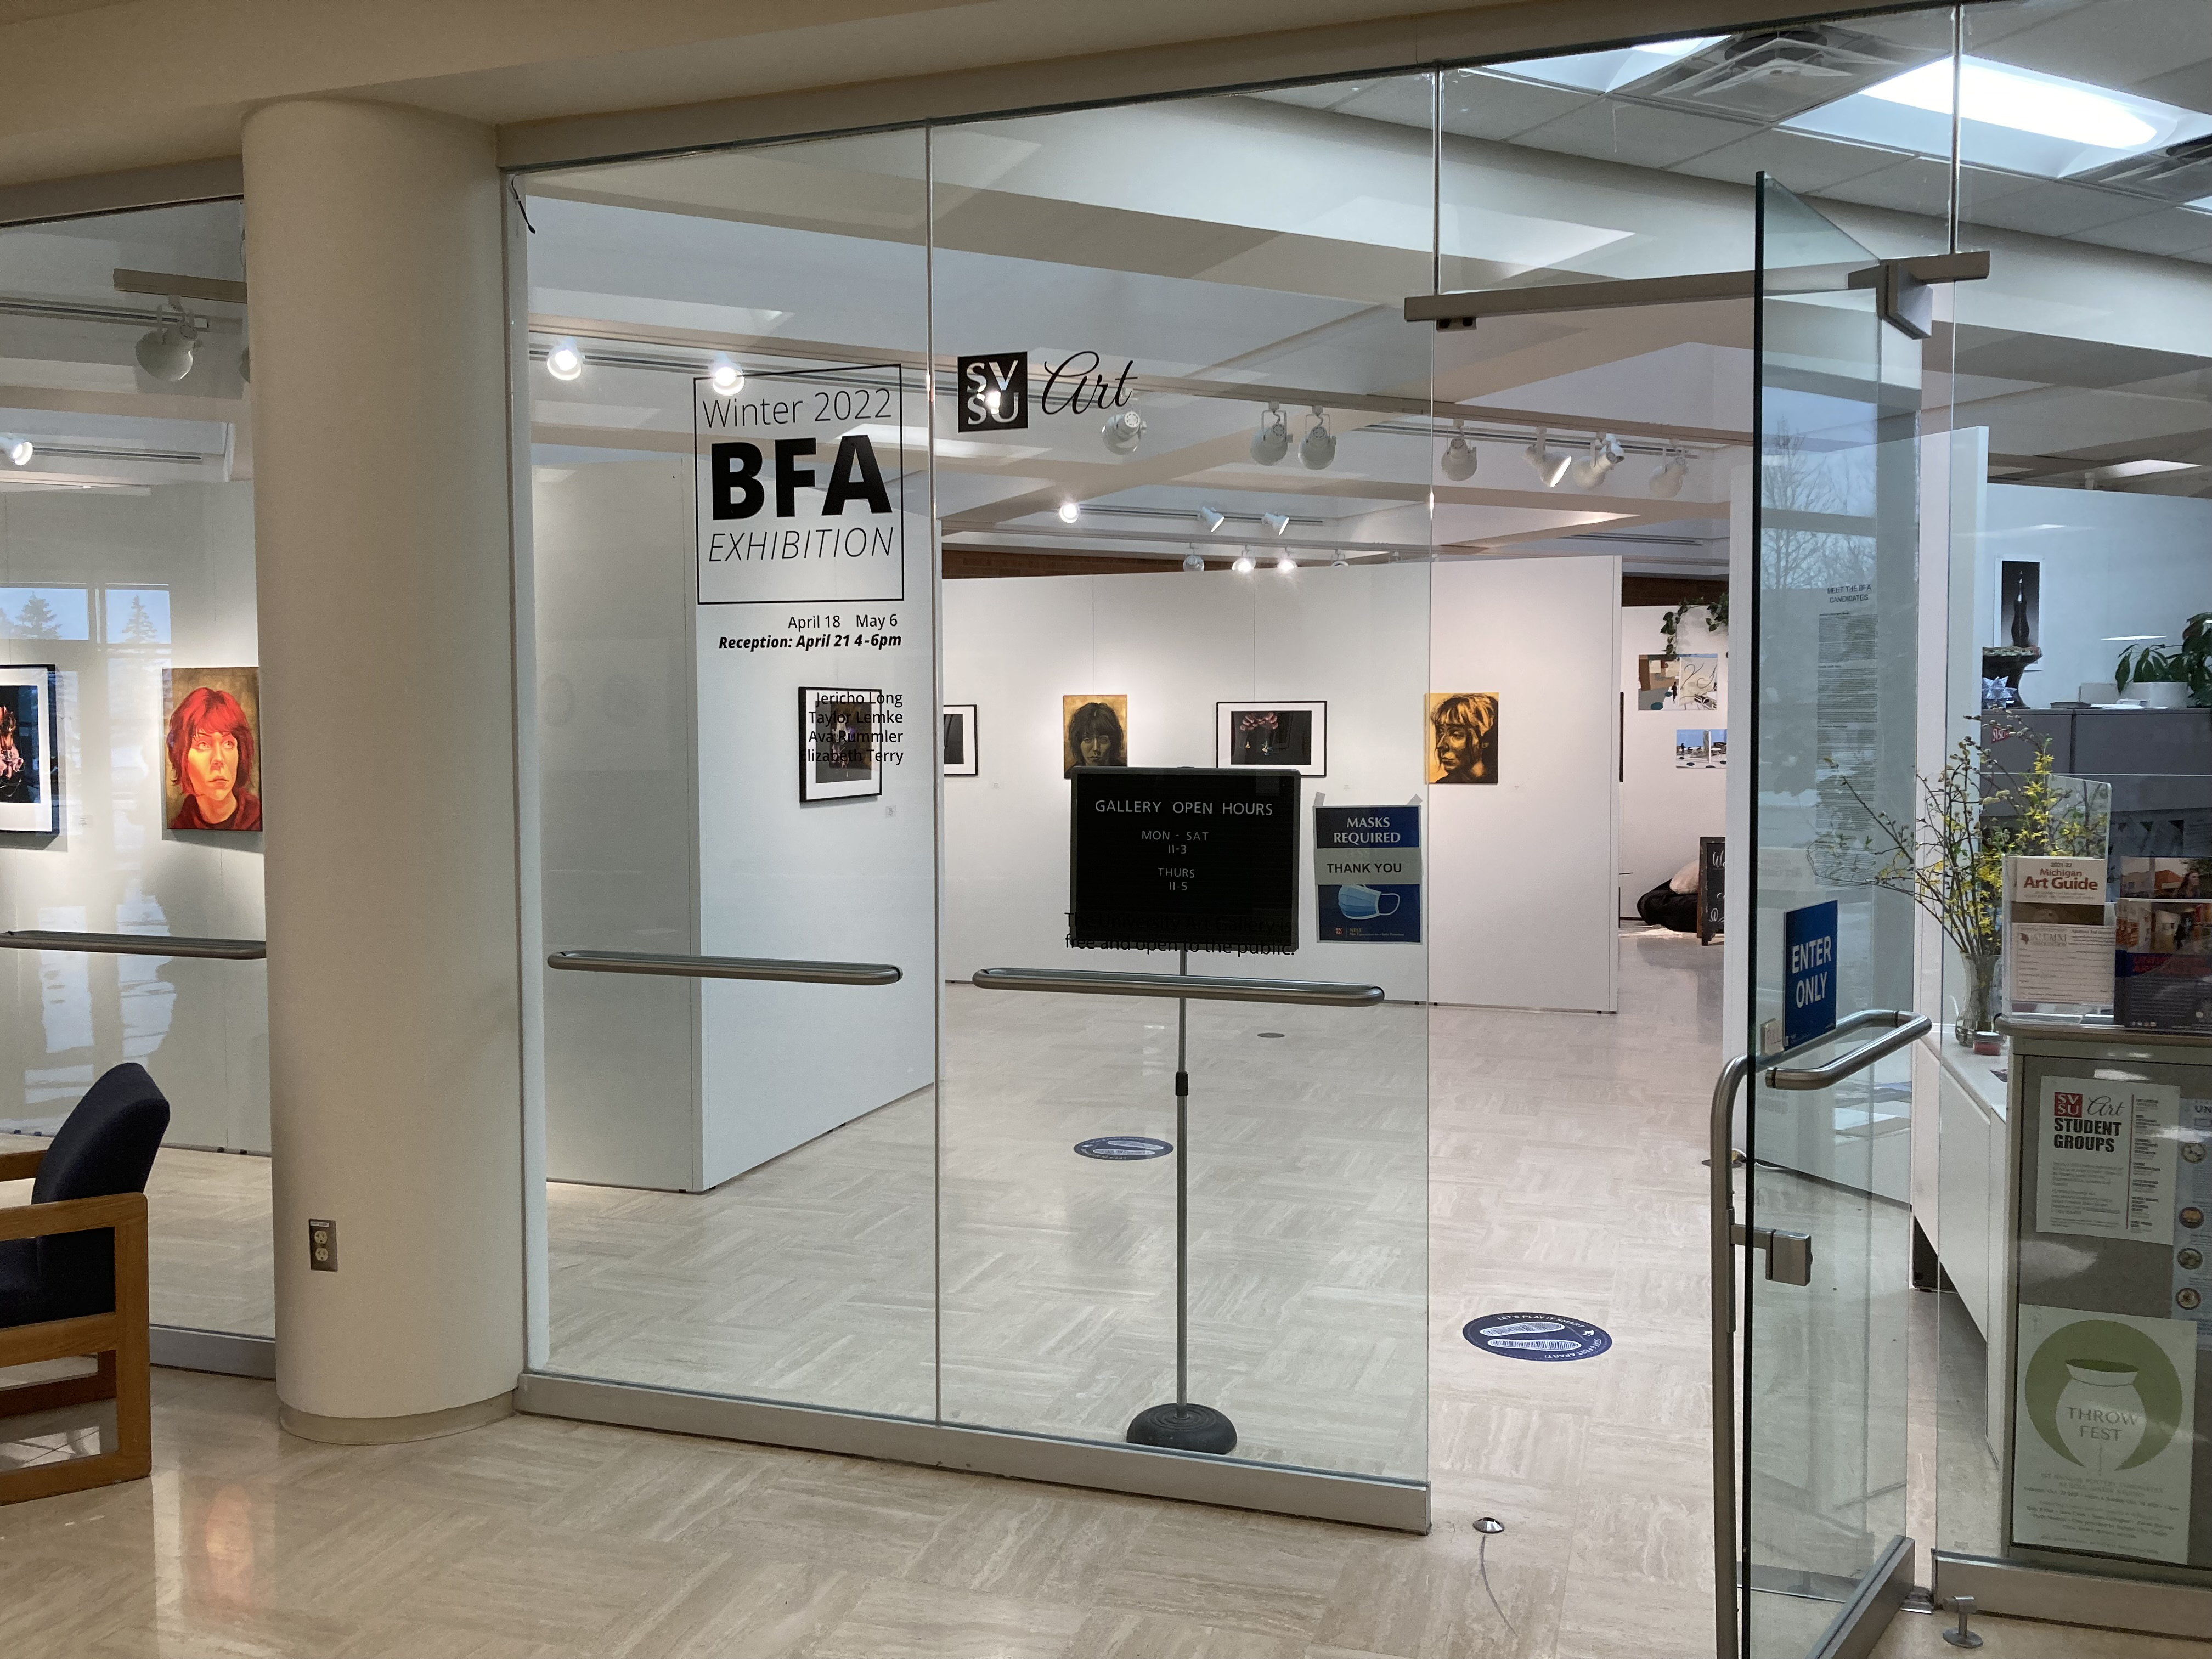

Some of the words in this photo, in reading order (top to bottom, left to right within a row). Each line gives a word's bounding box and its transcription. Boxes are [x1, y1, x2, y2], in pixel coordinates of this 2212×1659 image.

[1041, 351, 1138, 415] Art
[703, 397, 803, 429] Winter
[814, 387, 892, 422] 2022
[712, 435, 893, 521] BFA
[709, 527, 894, 562] EXHIBITION
[1830, 594, 1869, 603] CANDIDATES
[788, 615, 821, 631] April
[825, 615, 840, 628] 18
[856, 614, 885, 631] May
[889, 614, 898, 627] 6
[719, 635, 793, 652] Reception:
[796, 634, 831, 651] April
[833, 635, 850, 647] 21
[854, 634, 902, 649] 4-6pm
[816, 692, 864, 707] Jericho
[869, 692, 903, 708] Long
[809, 711, 852, 727] Taylor
[856, 710, 903, 724] Lemke
[809, 731, 834, 743] Ava
[839, 730, 904, 743] Rummler
[867, 748, 904, 766] Terry
[1096, 800, 1162, 814] GALLERY
[1172, 801, 1213, 815] OPEN
[1222, 802, 1273, 816] HOURS
[1347, 816, 1390, 828] MASKS
[1142, 830, 1170, 840] MON
[1187, 831, 1209, 842] SAT
[1333, 831, 1401, 844] REQUIRED
[1158, 867, 1195, 878] THURS
[1327, 863, 1370, 873] THANK
[1375, 862, 1402, 873] YOU
[2040, 868, 2083, 878] Michigan
[2024, 876, 2049, 888] Art
[2052, 877, 2098, 890] Guide
[1064, 912, 1095, 927] The
[1100, 913, 1181, 933] University
[1065, 933, 1095, 949] free
[1101, 936, 1131, 951] and
[1136, 939, 1178, 955] open
[1184, 940, 1200, 953] to
[1205, 940, 1232, 954] the
[1238, 941, 1295, 957] public.
[1792, 936, 1832, 974] ENTER
[1796, 972, 1827, 1008] ONLY
[2057, 1094, 2080, 1104] SV
[2087, 1096, 2125, 1116] Art
[2057, 1104, 2079, 1115] SU
[2054, 1118, 2122, 1136] STUDENT
[2054, 1134, 2115, 1153] GROUPS
[1556, 1318, 1585, 1328] SMART
[2067, 1407, 2139, 1426] THROW
[2079, 1426, 2123, 1442] FEST
